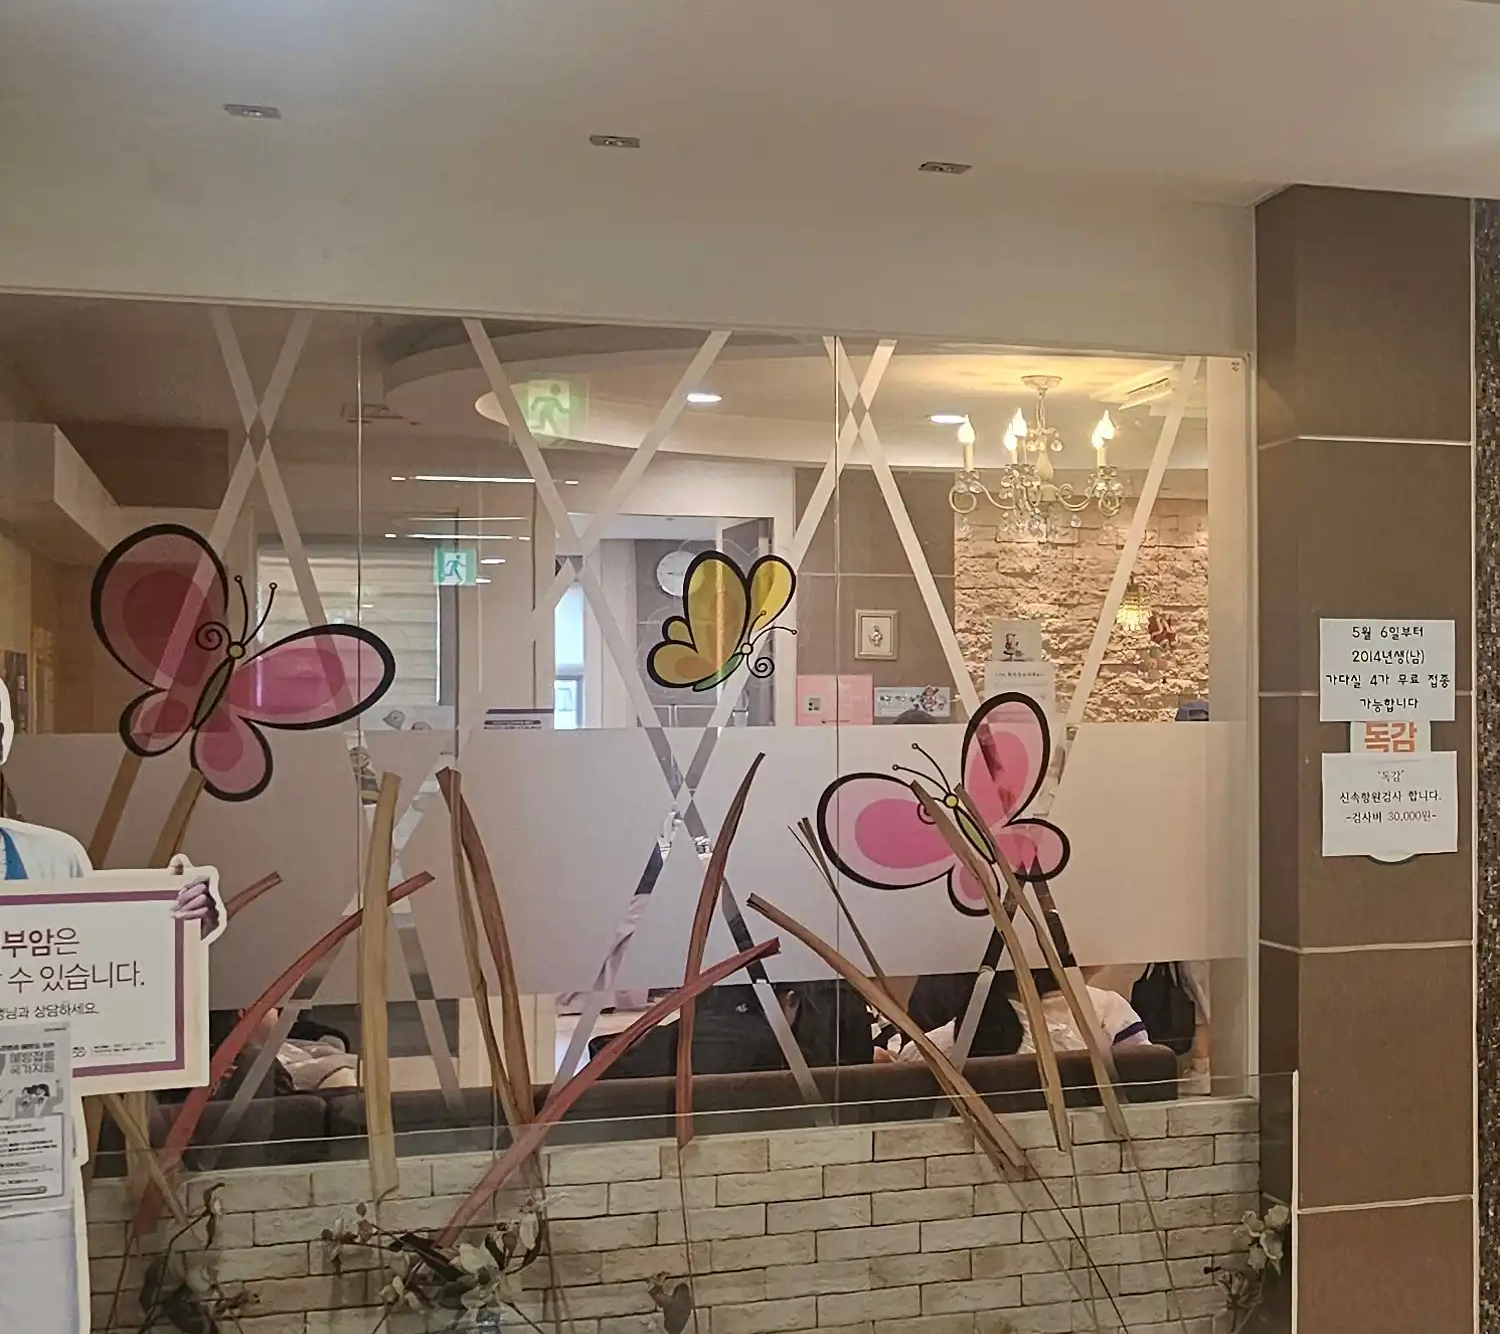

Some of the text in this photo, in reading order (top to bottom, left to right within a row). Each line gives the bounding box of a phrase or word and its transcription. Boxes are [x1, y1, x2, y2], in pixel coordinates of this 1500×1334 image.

[1352, 626, 1424, 641] 5월 6일부터
[1352, 650, 1425, 665] 2014년생(남)
[1326, 673, 1450, 688] 가다실 4가 무료 접종
[1360, 698, 1419, 713] 가능합니다
[1364, 722, 1417, 753] 독감
[1340, 791, 1402, 804] 신속항원검사
[8, 960, 145, 994] 수 있습니다.
